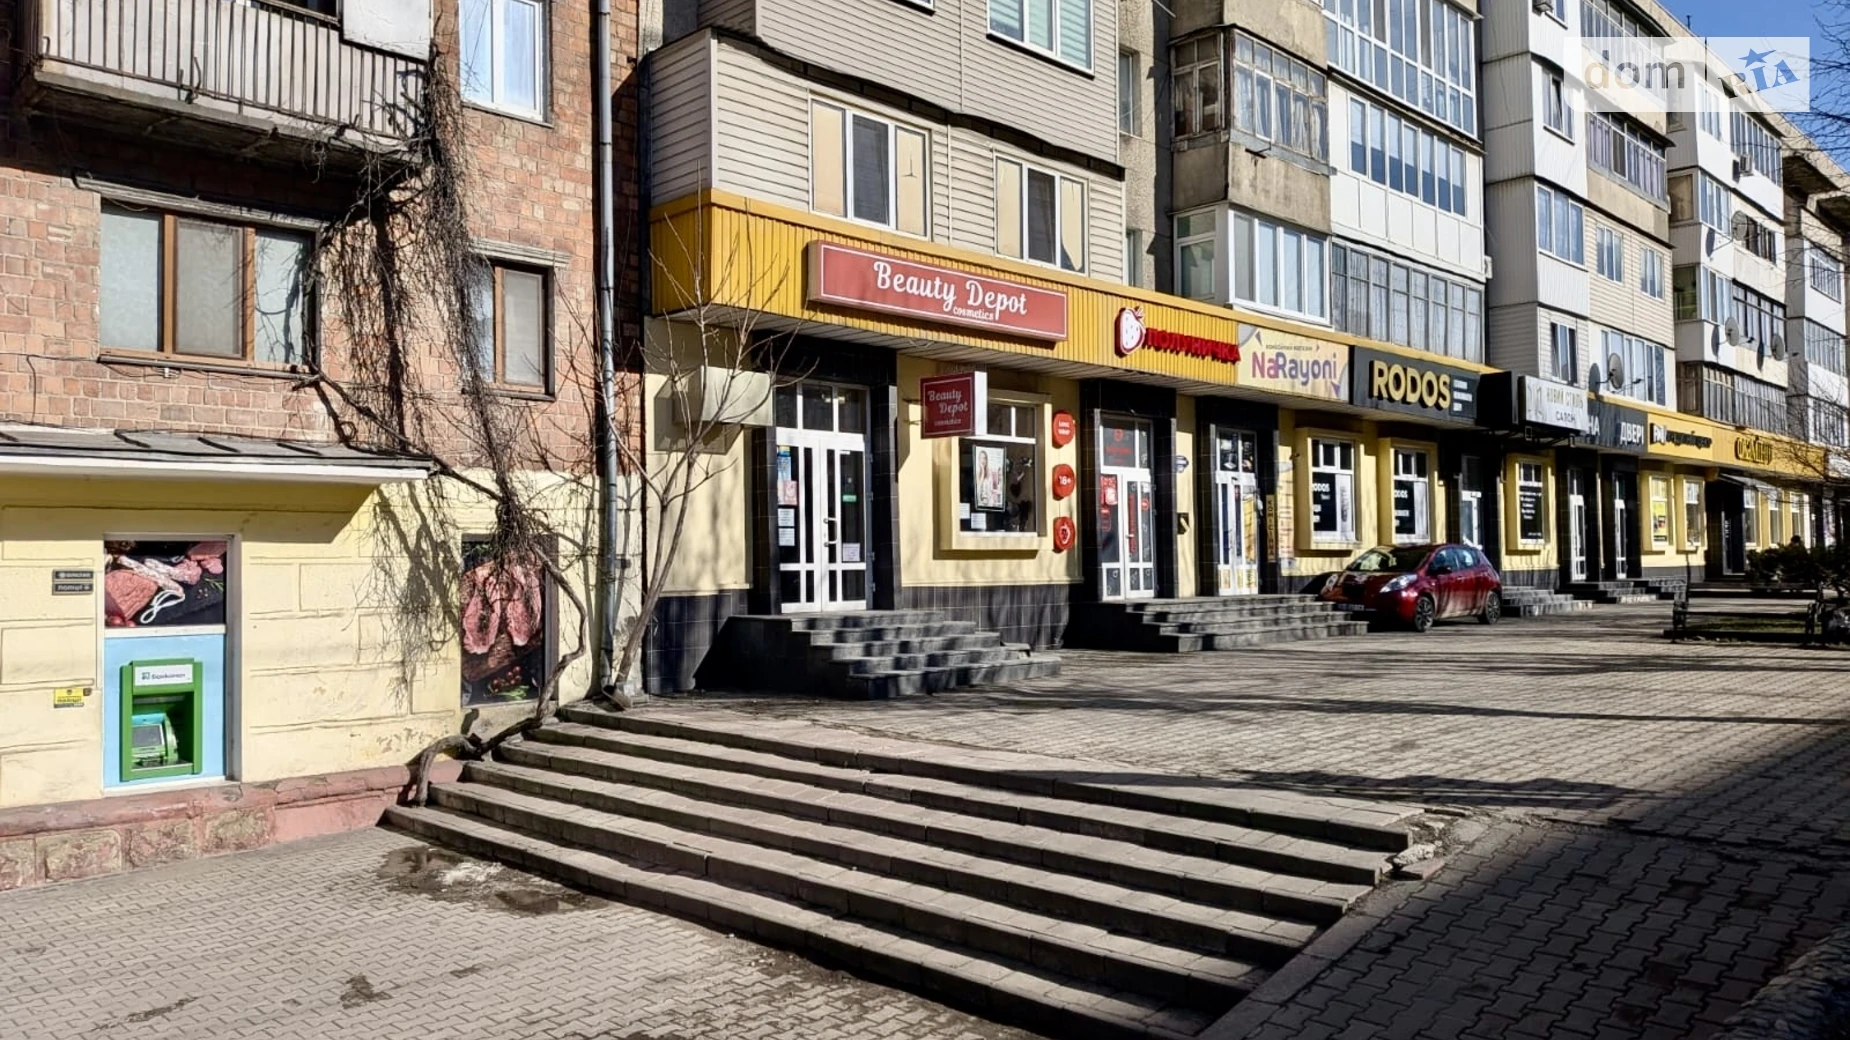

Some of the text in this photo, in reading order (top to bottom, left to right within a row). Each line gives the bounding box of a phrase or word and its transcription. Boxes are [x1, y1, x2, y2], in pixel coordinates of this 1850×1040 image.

[873, 261, 1027, 321] Beauty Depot
[953, 305, 994, 320] cosmetics
[1143, 327, 1241, 364] ПОЛУНИЧКА
[1251, 351, 1337, 387] NaRayoni
[927, 388, 962, 403] Beauty
[1371, 359, 1451, 410] RODOS
[938, 400, 969, 417] Depot
[1620, 421, 1645, 445] ДВЕРІ
[1058, 474, 1072, 486] 18+
